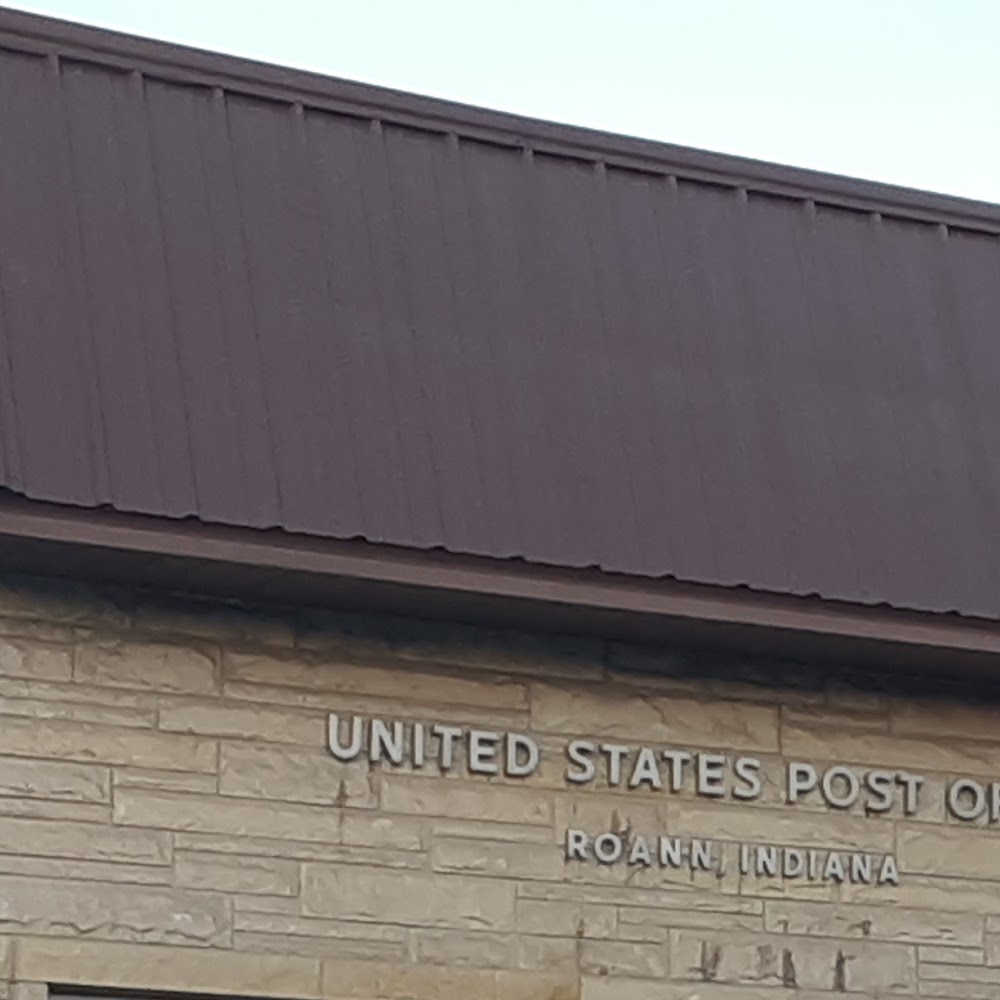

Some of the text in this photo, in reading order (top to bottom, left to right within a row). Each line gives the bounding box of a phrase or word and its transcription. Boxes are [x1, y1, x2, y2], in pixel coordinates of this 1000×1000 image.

[327, 713, 539, 778] UNITED
[565, 740, 762, 799] STATES
[785, 761, 924, 815] POST
[739, 843, 900, 886] INDIANA
